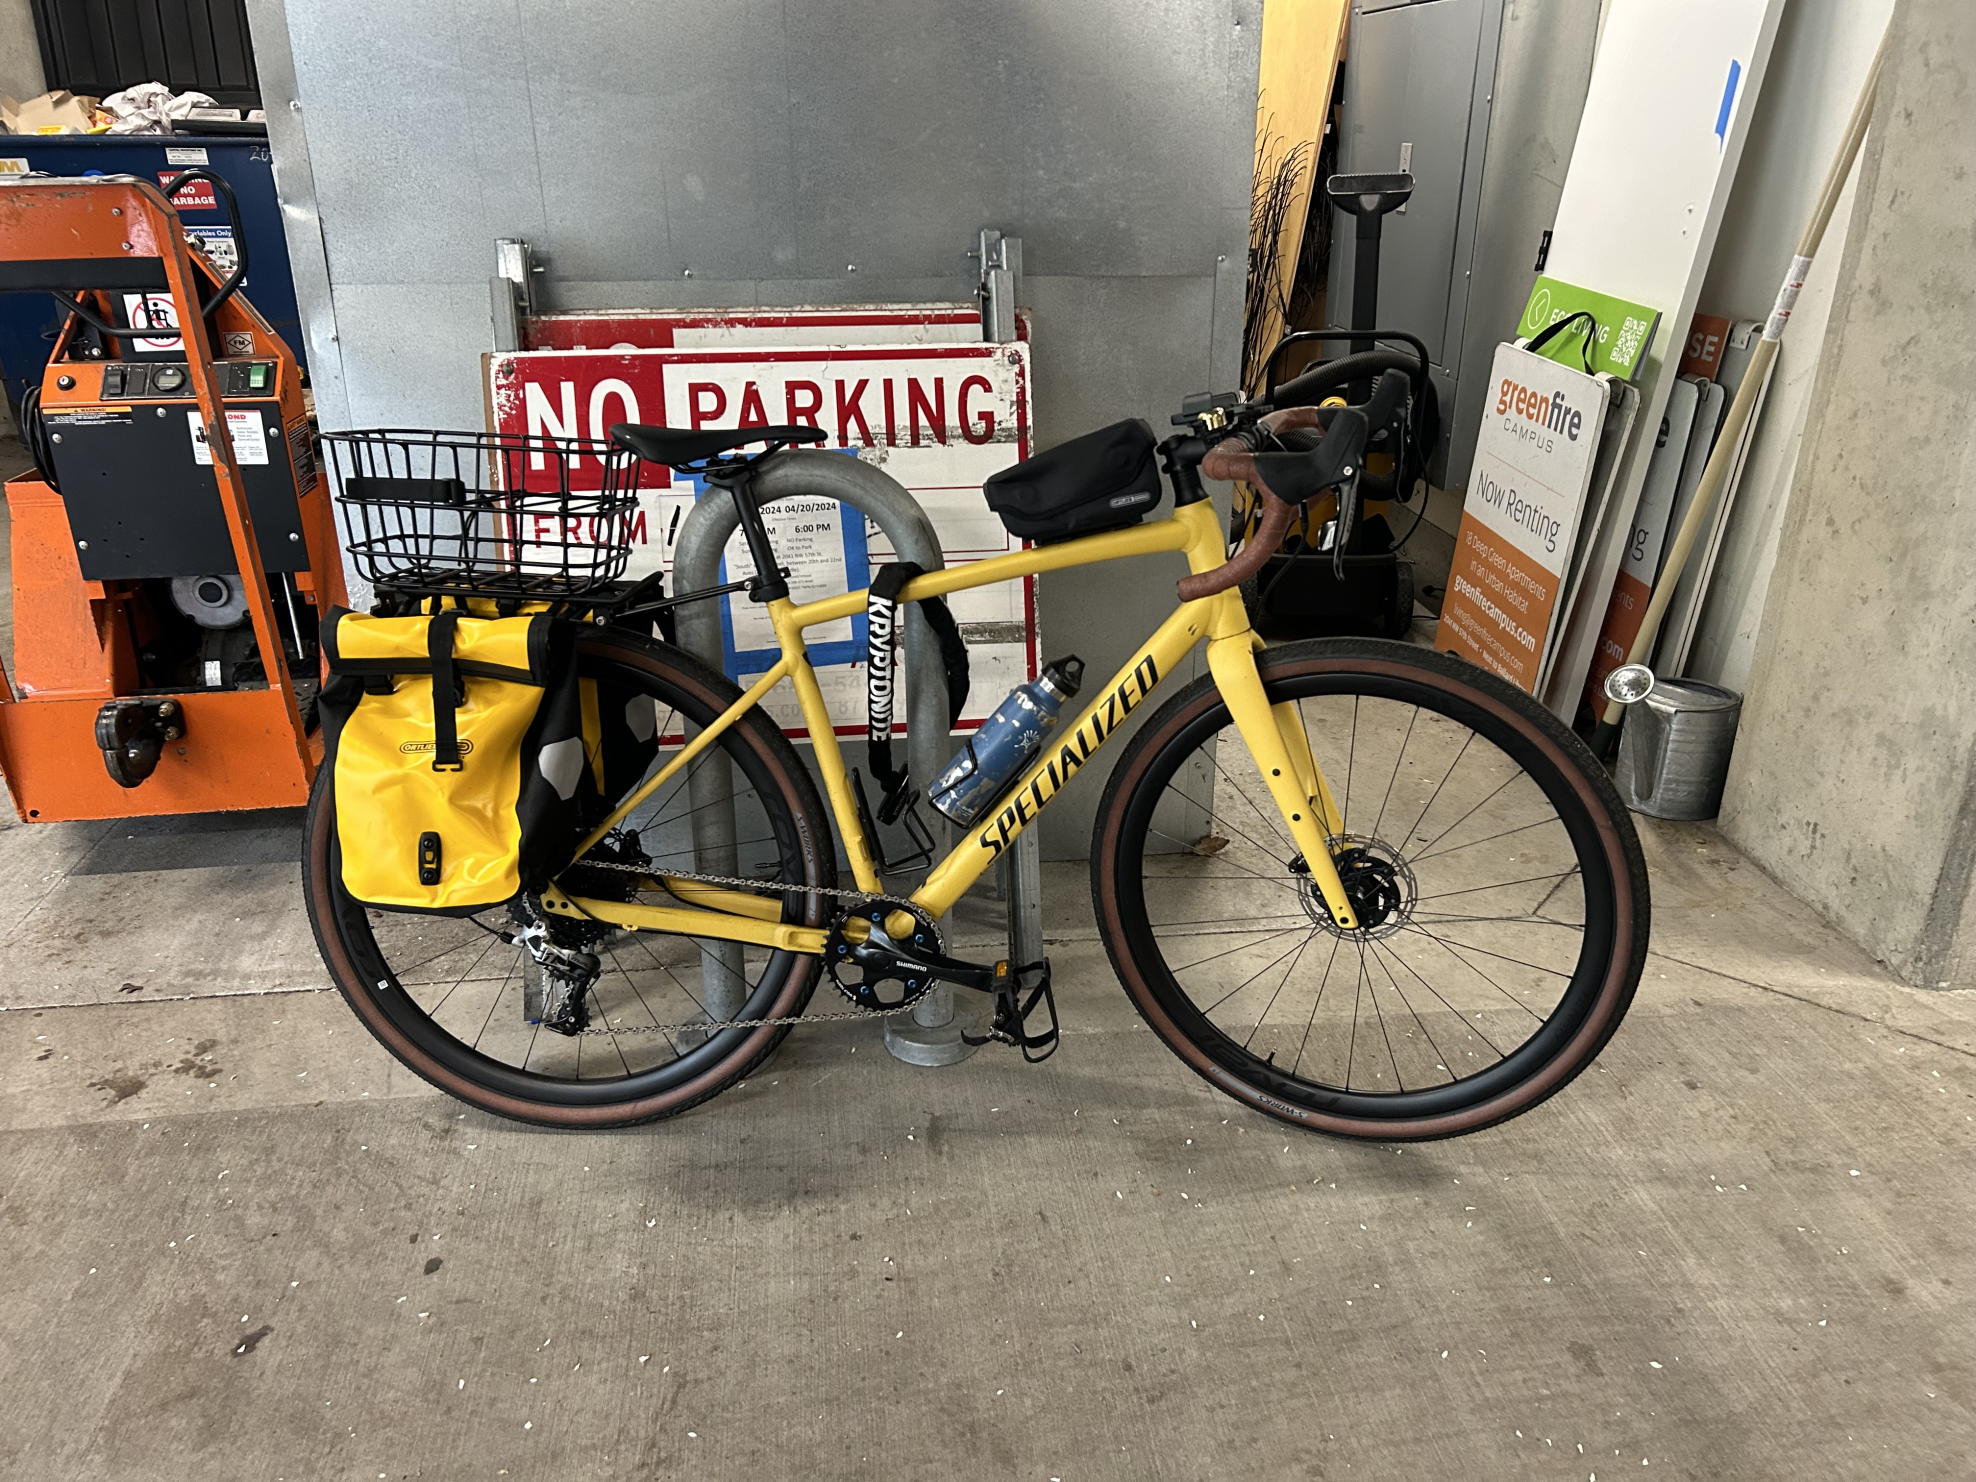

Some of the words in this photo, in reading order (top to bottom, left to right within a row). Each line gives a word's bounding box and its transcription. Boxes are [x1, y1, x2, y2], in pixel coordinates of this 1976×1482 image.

[170, 196, 216, 205] ARBAGE
[180, 186, 195, 194] NO
[1687, 332, 1719, 362] SE
[525, 378, 641, 470] NO
[688, 374, 996, 448] PARKING
[1496, 378, 1582, 442] greenfire
[1504, 417, 1554, 454] CAMPUS
[533, 510, 648, 548] FROM
[767, 527, 777, 535] M
[795, 524, 814, 534] 6:00
[816, 523, 831, 533] PM
[785, 502, 837, 514] 04/20/2024
[1476, 469, 1506, 510] Now
[1505, 488, 1561, 553] Renting
[1465, 530, 1473, 545] 18
[1472, 535, 1488, 559] Deep
[1488, 547, 1507, 571] Green
[1505, 561, 1546, 601] Apartments
[1470, 556, 1477, 572] in
[1476, 565, 1485, 579] an
[1484, 569, 1504, 595] Urban
[1503, 586, 1529, 615] Habitat
[1453, 574, 1536, 653] greenfirecampus.com
[1453, 602, 1524, 674] living@greenfirecampus.com
[868, 594, 893, 742] KRYPTONITE
[979, 654, 1159, 864] SPECIALIZED
[896, 960, 927, 972] SHIMANO
[1258, 1095, 1306, 1118] S-WORKS
